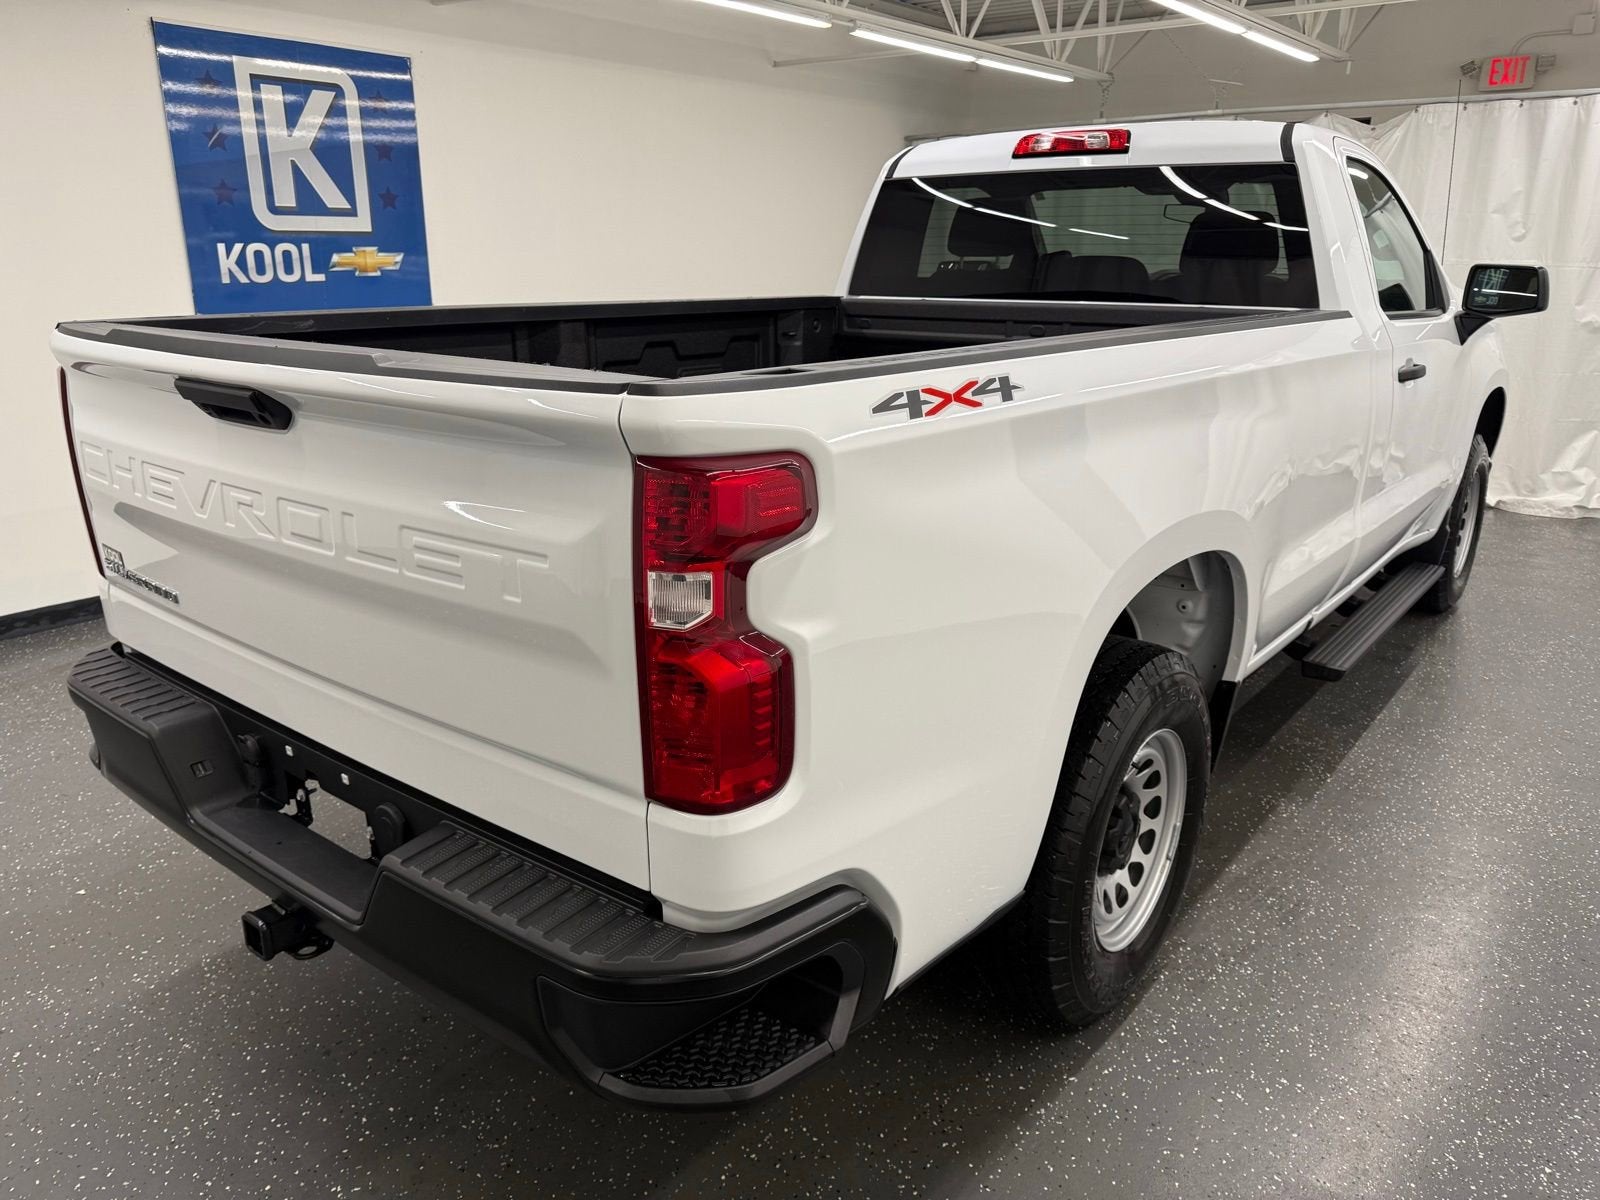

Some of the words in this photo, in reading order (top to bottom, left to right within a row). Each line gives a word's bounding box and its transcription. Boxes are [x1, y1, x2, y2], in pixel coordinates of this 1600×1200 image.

[1488, 55, 1531, 86] EXIT
[260, 82, 352, 209] K
[216, 242, 326, 284] KOOL
[80, 440, 549, 603] CHEVROLET
